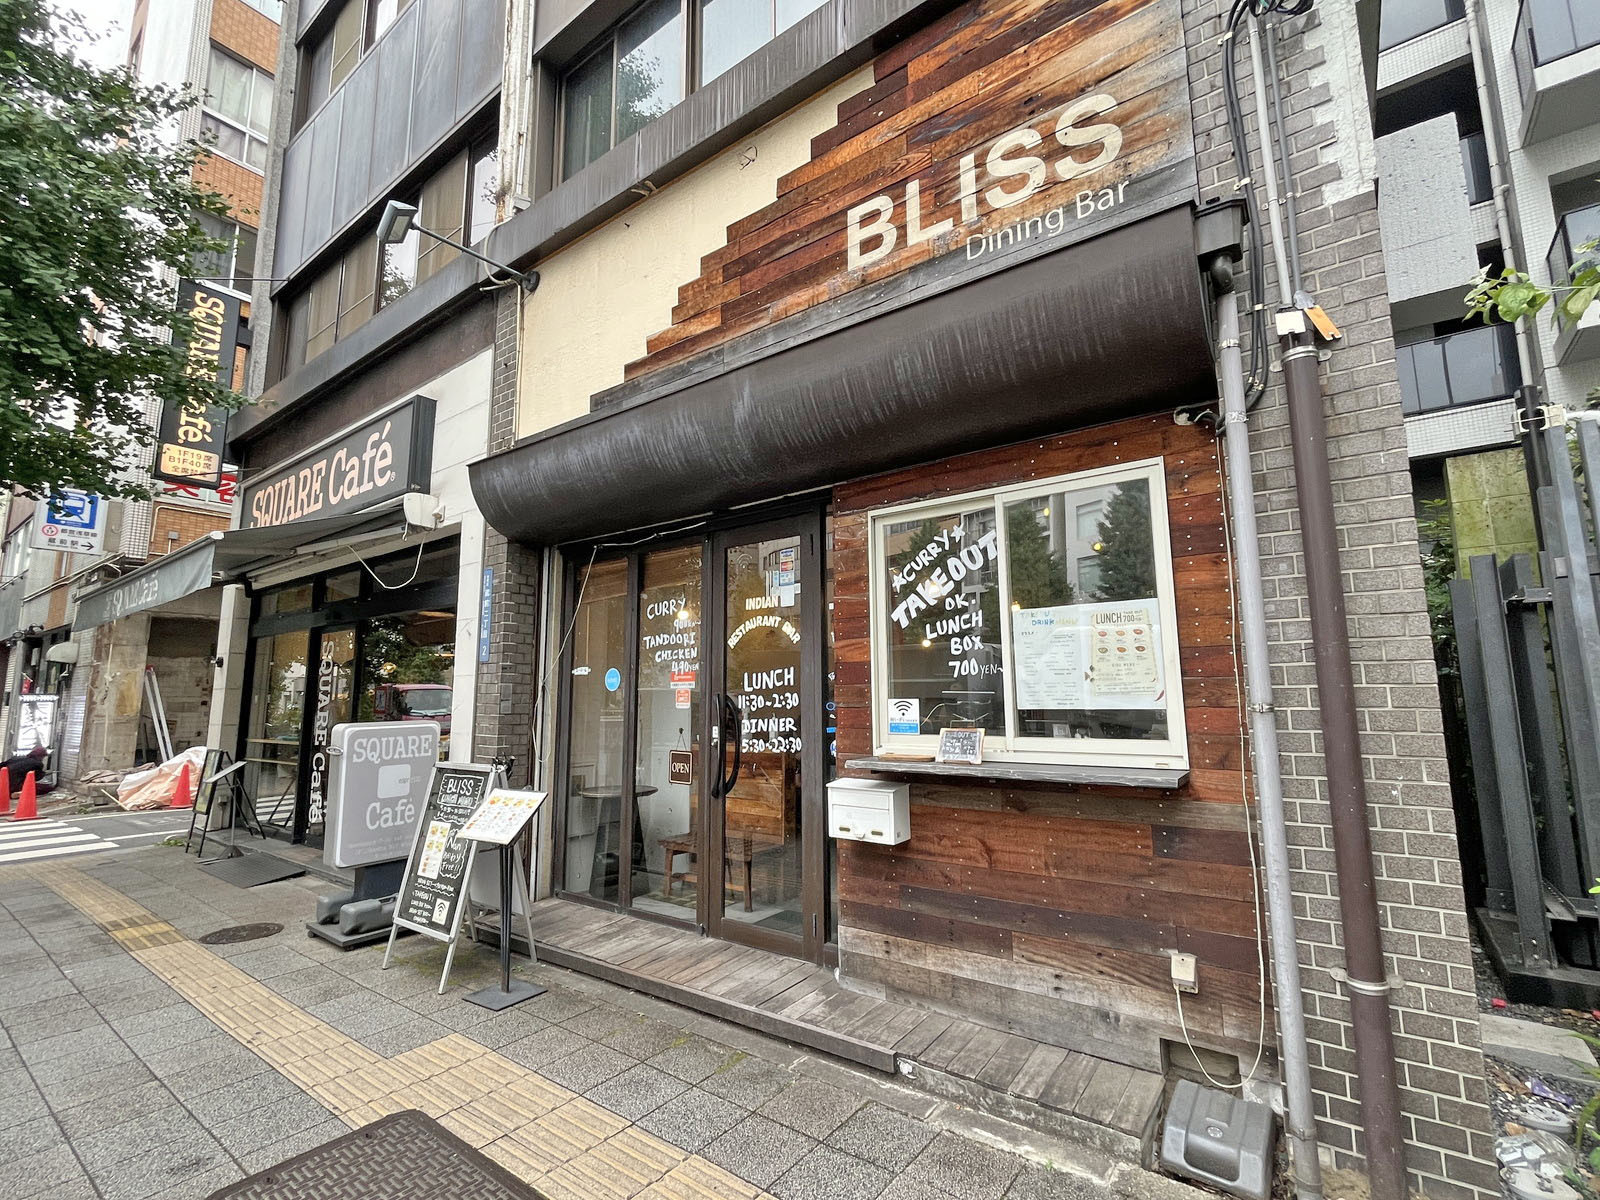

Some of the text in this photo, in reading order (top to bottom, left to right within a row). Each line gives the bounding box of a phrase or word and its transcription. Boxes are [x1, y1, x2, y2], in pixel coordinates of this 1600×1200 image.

[847, 93, 1123, 271] BLISS
[966, 180, 1131, 260] Dining Bar
[250, 421, 393, 528] SQUARE Café
[903, 529, 950, 582] CURRY
[647, 598, 686, 620] CURRY
[745, 595, 779, 610] INDIAN
[925, 609, 983, 639] LUNCH
[1031, 618, 1055, 626] DRINK
[1095, 612, 1122, 625] LUNCH
[643, 632, 696, 649] TANDOORI
[727, 615, 802, 649] RESTAURANT BAR
[655, 647, 698, 662] CHICKEN
[950, 635, 984, 655] BOX
[743, 666, 795, 692] LUNCH
[314, 641, 334, 746] SQUARE
[741, 717, 798, 733] DINNER
[352, 734, 433, 764] SQUARE
[671, 762, 690, 774] OPEN
[446, 778, 474, 796] BLISS
